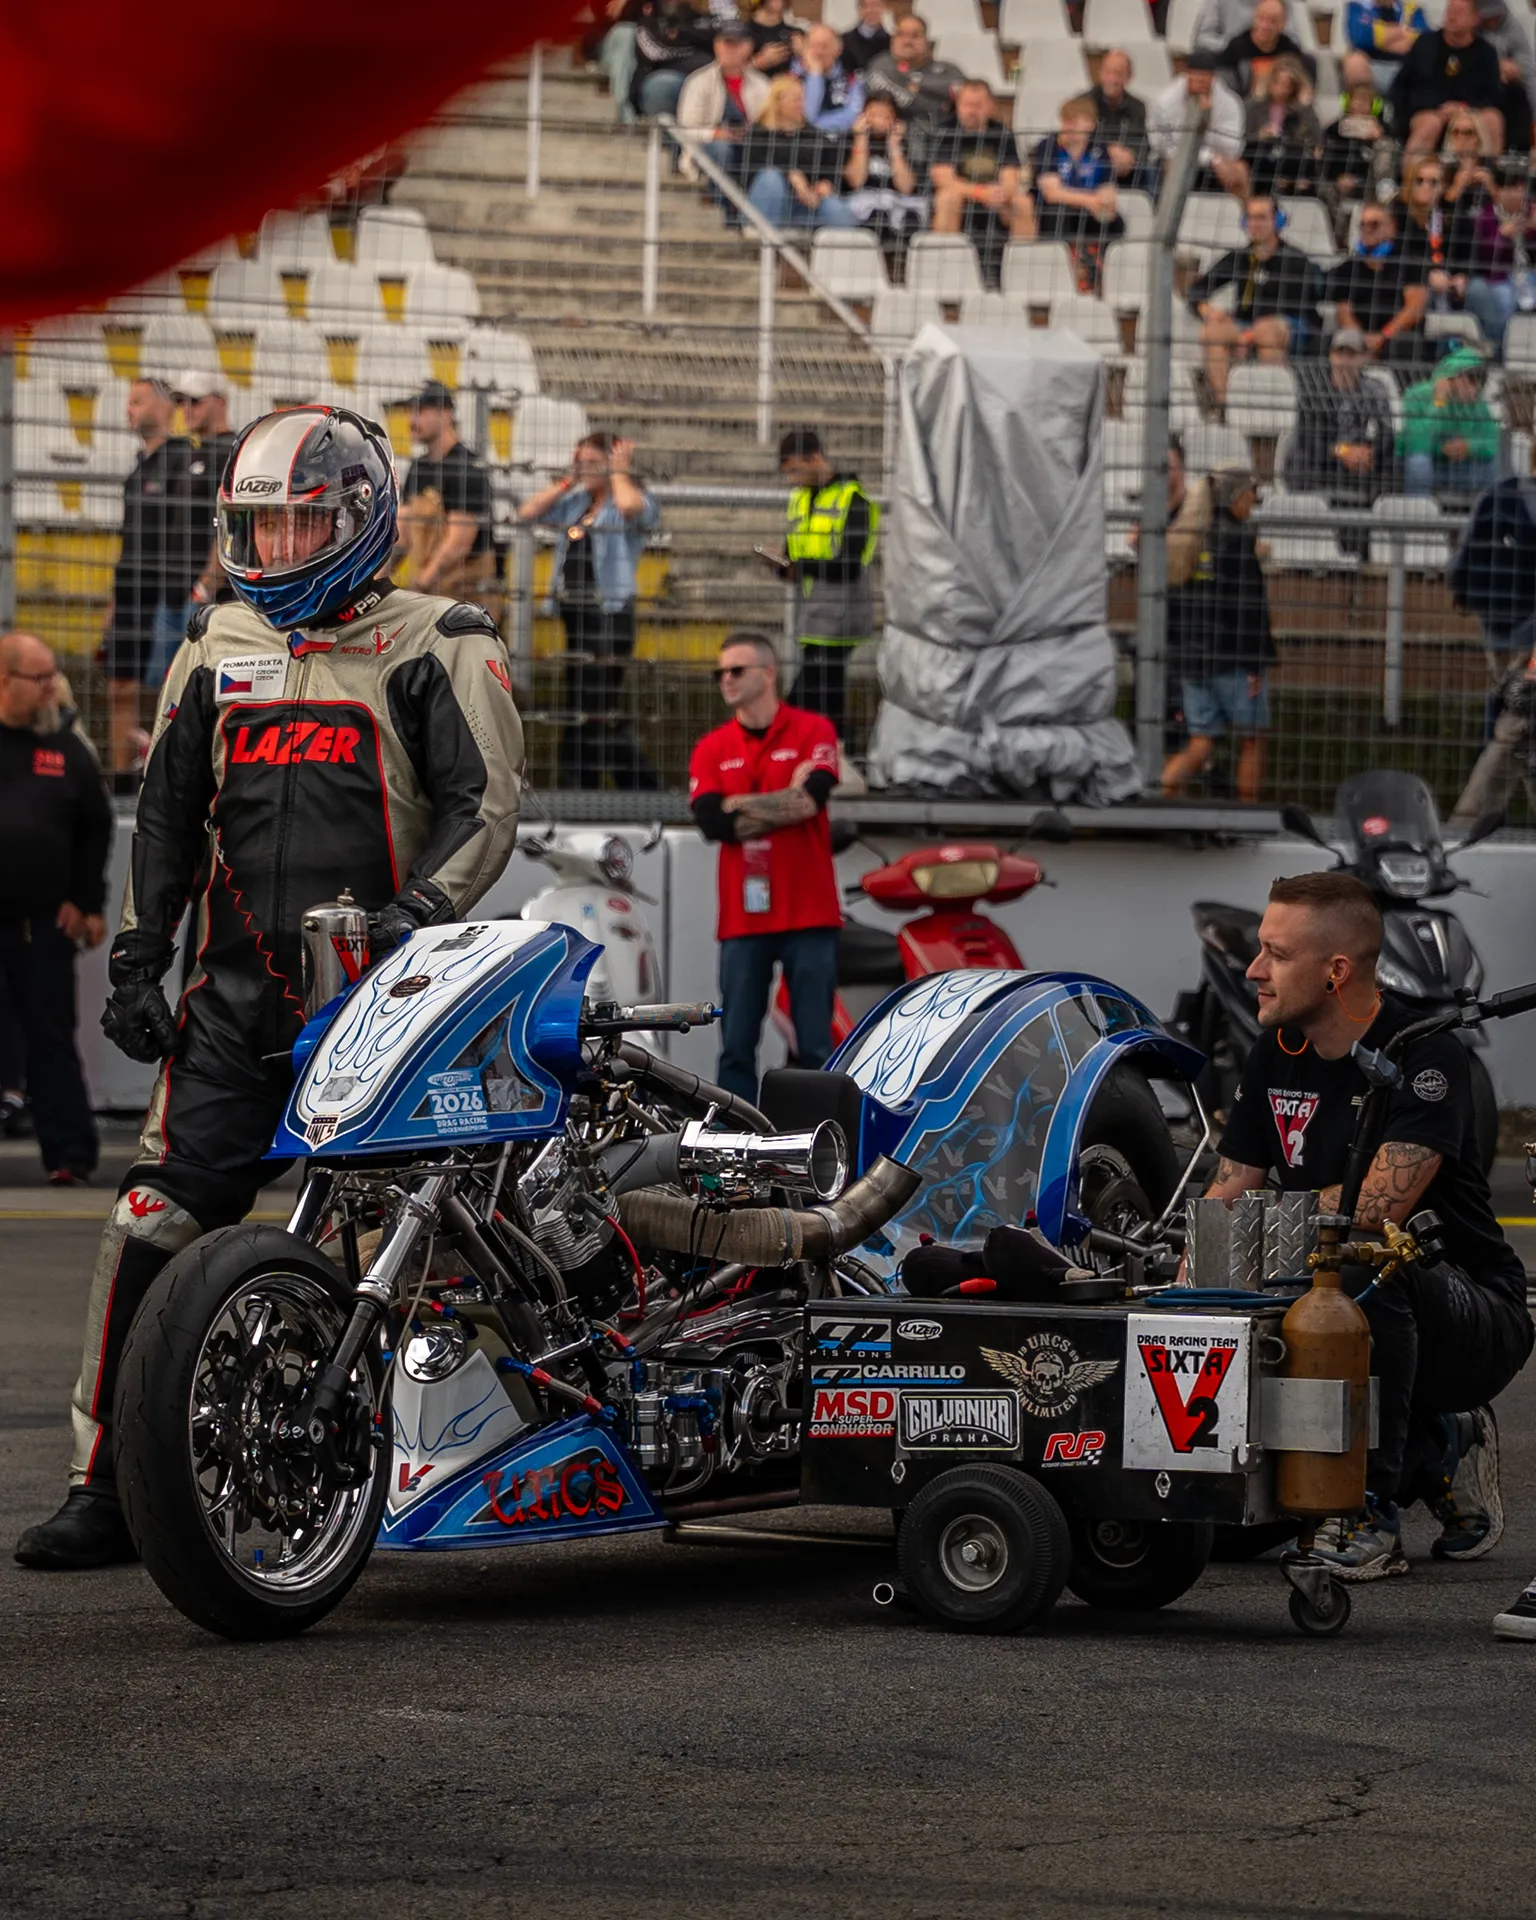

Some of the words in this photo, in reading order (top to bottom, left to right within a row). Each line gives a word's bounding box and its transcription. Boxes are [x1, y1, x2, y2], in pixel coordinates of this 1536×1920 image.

[236, 480, 283, 493] LAZER
[231, 722, 360, 765] LAZER
[431, 1092, 484, 1114] 2026
[1275, 1099, 1311, 1118] SIXTA
[436, 1119, 458, 1128] DRAG
[459, 1116, 487, 1126] RACING
[903, 1323, 938, 1336] LAZER
[1026, 1333, 1071, 1352] UNCS
[1137, 1335, 1166, 1345] DRAG
[1169, 1336, 1207, 1347] RACING
[1210, 1337, 1239, 1348] TEAM
[810, 1349, 892, 1359] PISTONS
[1150, 1349, 1223, 1376] SIXTA
[863, 1365, 966, 1379] CARRILLO
[814, 1391, 895, 1421] MSD
[1017, 1387, 1078, 1418] UNLIMITED
[838, 1415, 874, 1424] SUPER
[908, 1399, 1012, 1439] GALVANIKA
[811, 1423, 893, 1436] CONDUCTOR
[930, 1434, 990, 1443] PRAHA
